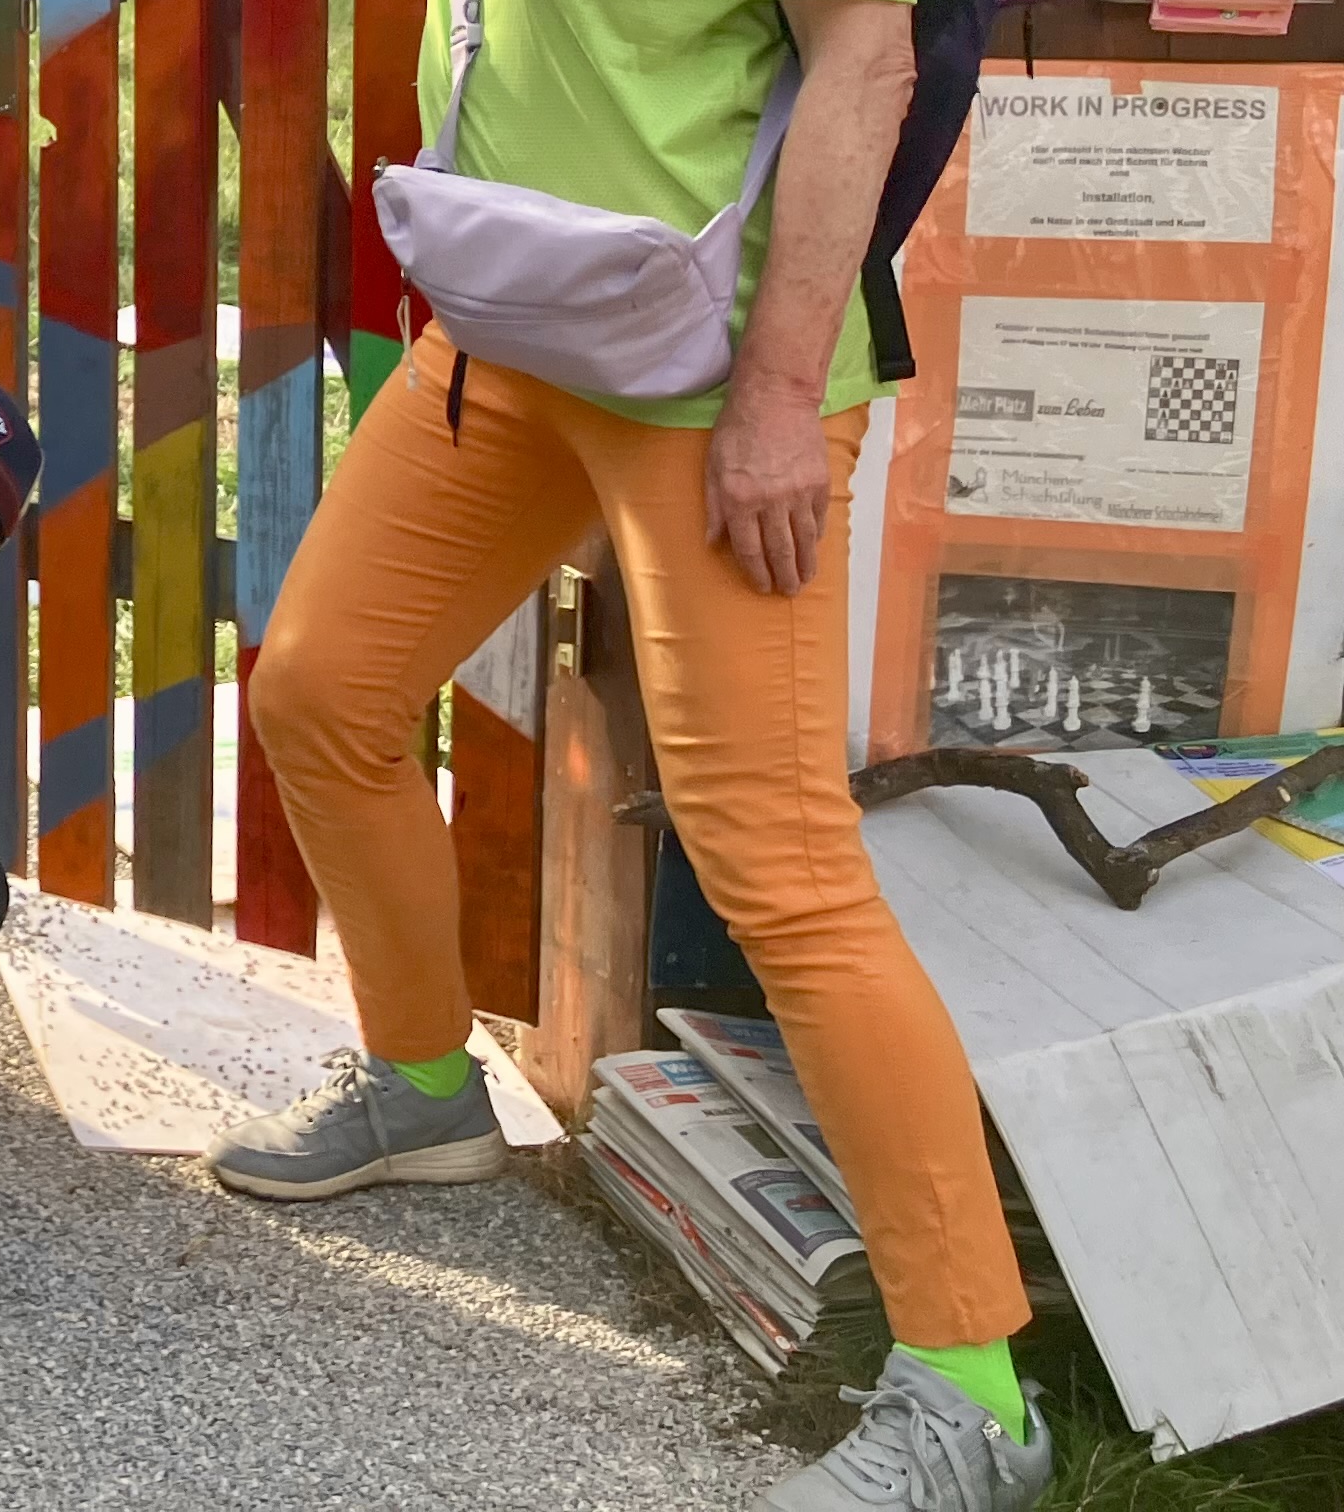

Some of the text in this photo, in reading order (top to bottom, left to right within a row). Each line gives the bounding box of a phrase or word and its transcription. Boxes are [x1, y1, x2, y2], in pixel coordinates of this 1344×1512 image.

[983, 95, 1267, 120] WORK IN PROGRESS
[1064, 397, 1106, 418] Leben
